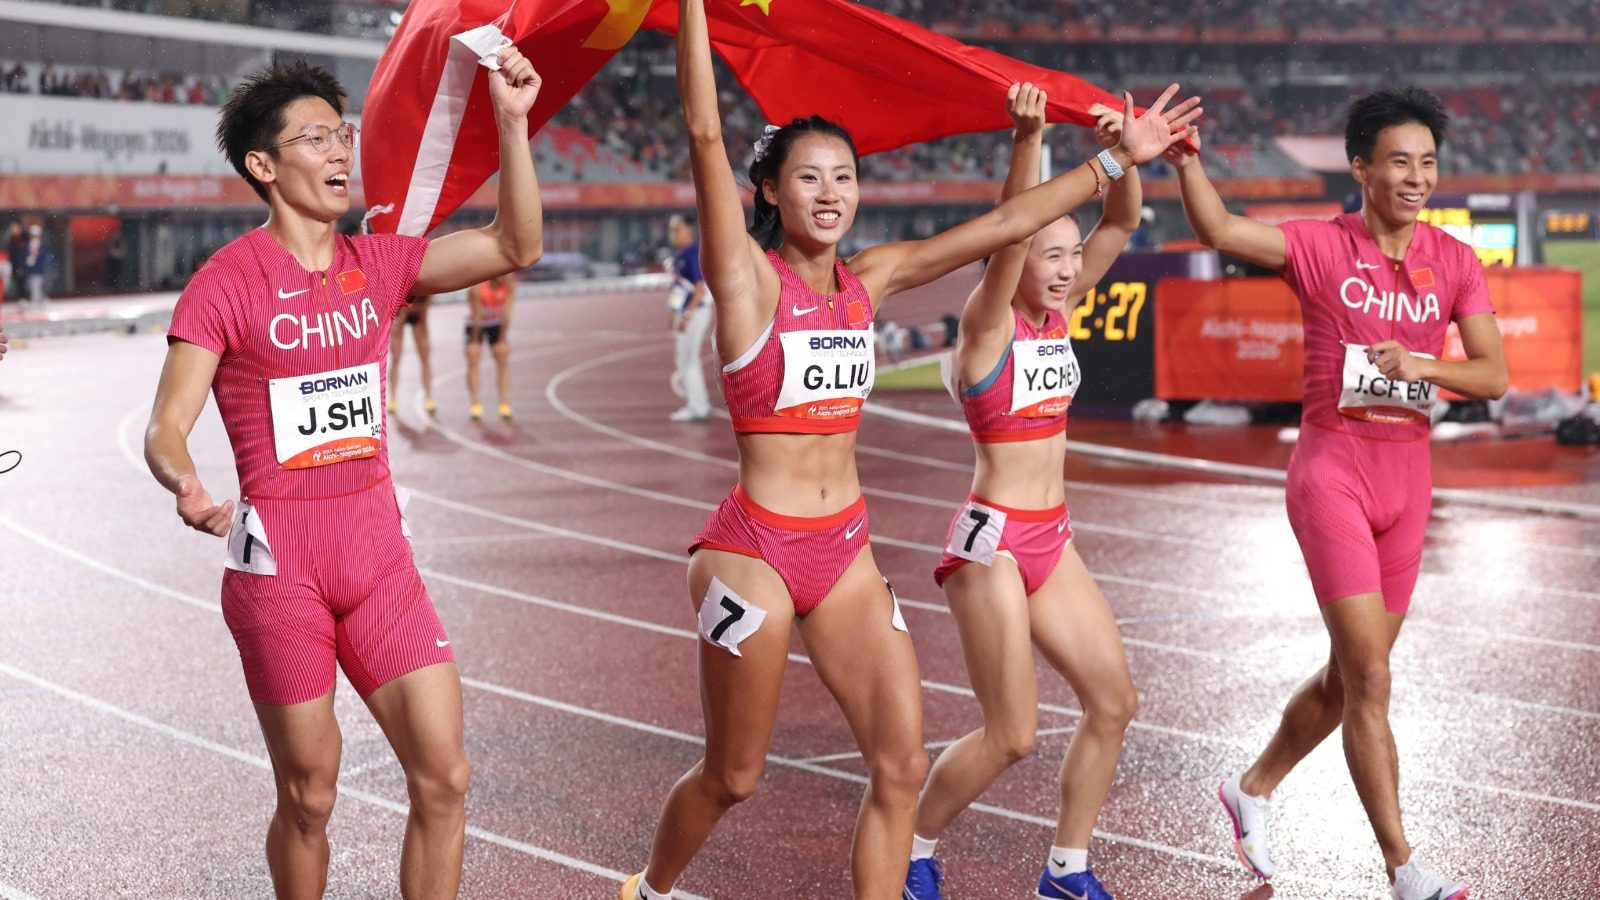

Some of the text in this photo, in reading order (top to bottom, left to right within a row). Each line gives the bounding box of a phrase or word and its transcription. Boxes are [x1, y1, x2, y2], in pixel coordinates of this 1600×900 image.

[1340, 277, 1440, 323] CHINA
[269, 297, 379, 349] CHINA
[808, 336, 867, 350] BORNA
[298, 371, 368, 395] BORNAN
[803, 360, 870, 390] G.LIU
[297, 396, 374, 436] J.SHI
[963, 509, 990, 552] 7
[710, 595, 745, 642] 7
